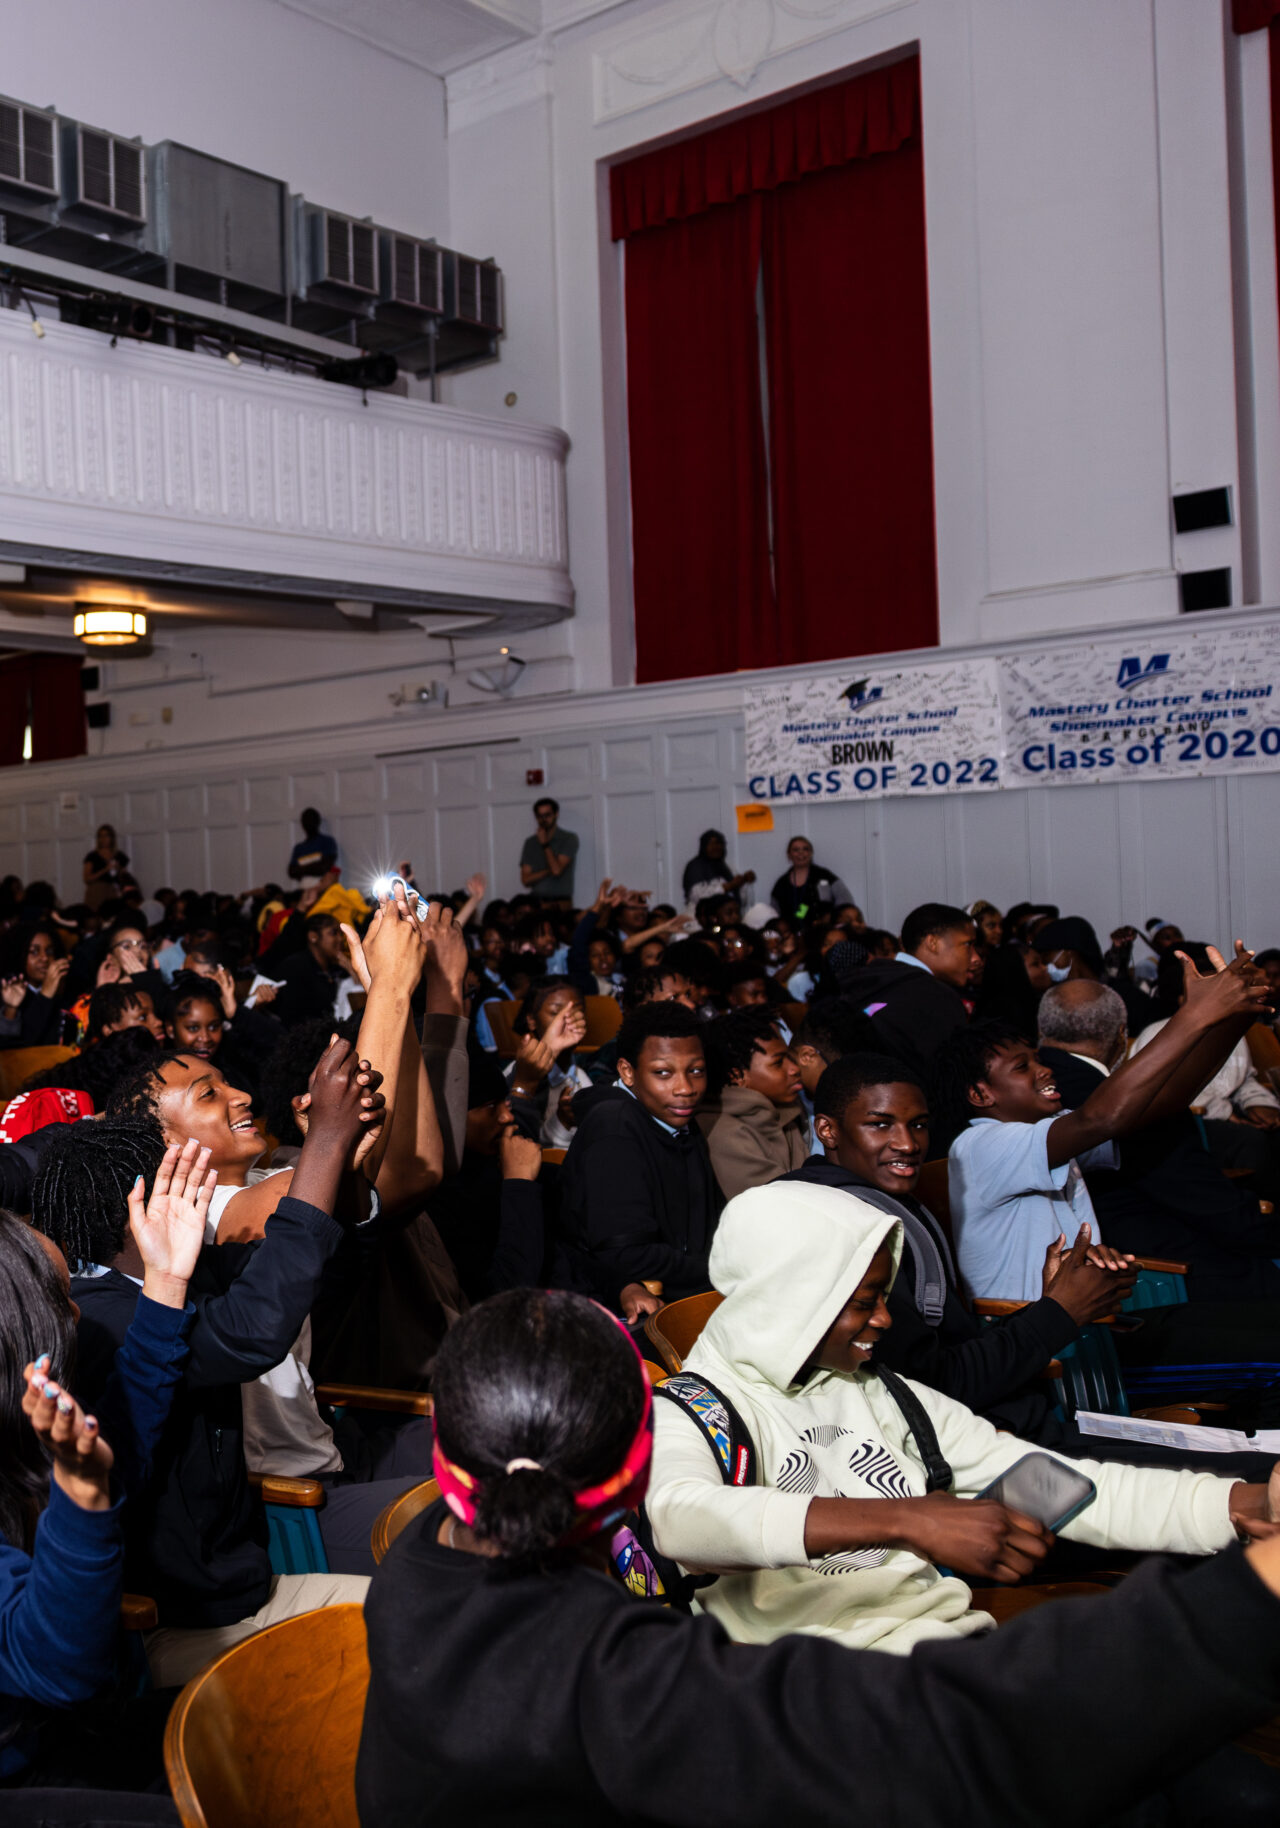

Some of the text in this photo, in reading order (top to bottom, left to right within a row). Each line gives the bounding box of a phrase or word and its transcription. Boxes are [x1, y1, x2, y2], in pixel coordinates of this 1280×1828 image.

[1028, 684, 1273, 718] Mastery Charter School
[782, 706, 958, 734] Mastery Charter School
[1050, 707, 1249, 733] Shoemaker Campus
[797, 724, 940, 745] Shoemaker Campus
[831, 740, 895, 765] BROWN
[1022, 727, 1280, 772] Class of 2020
[748, 757, 999, 799] CLASS OF 2022
